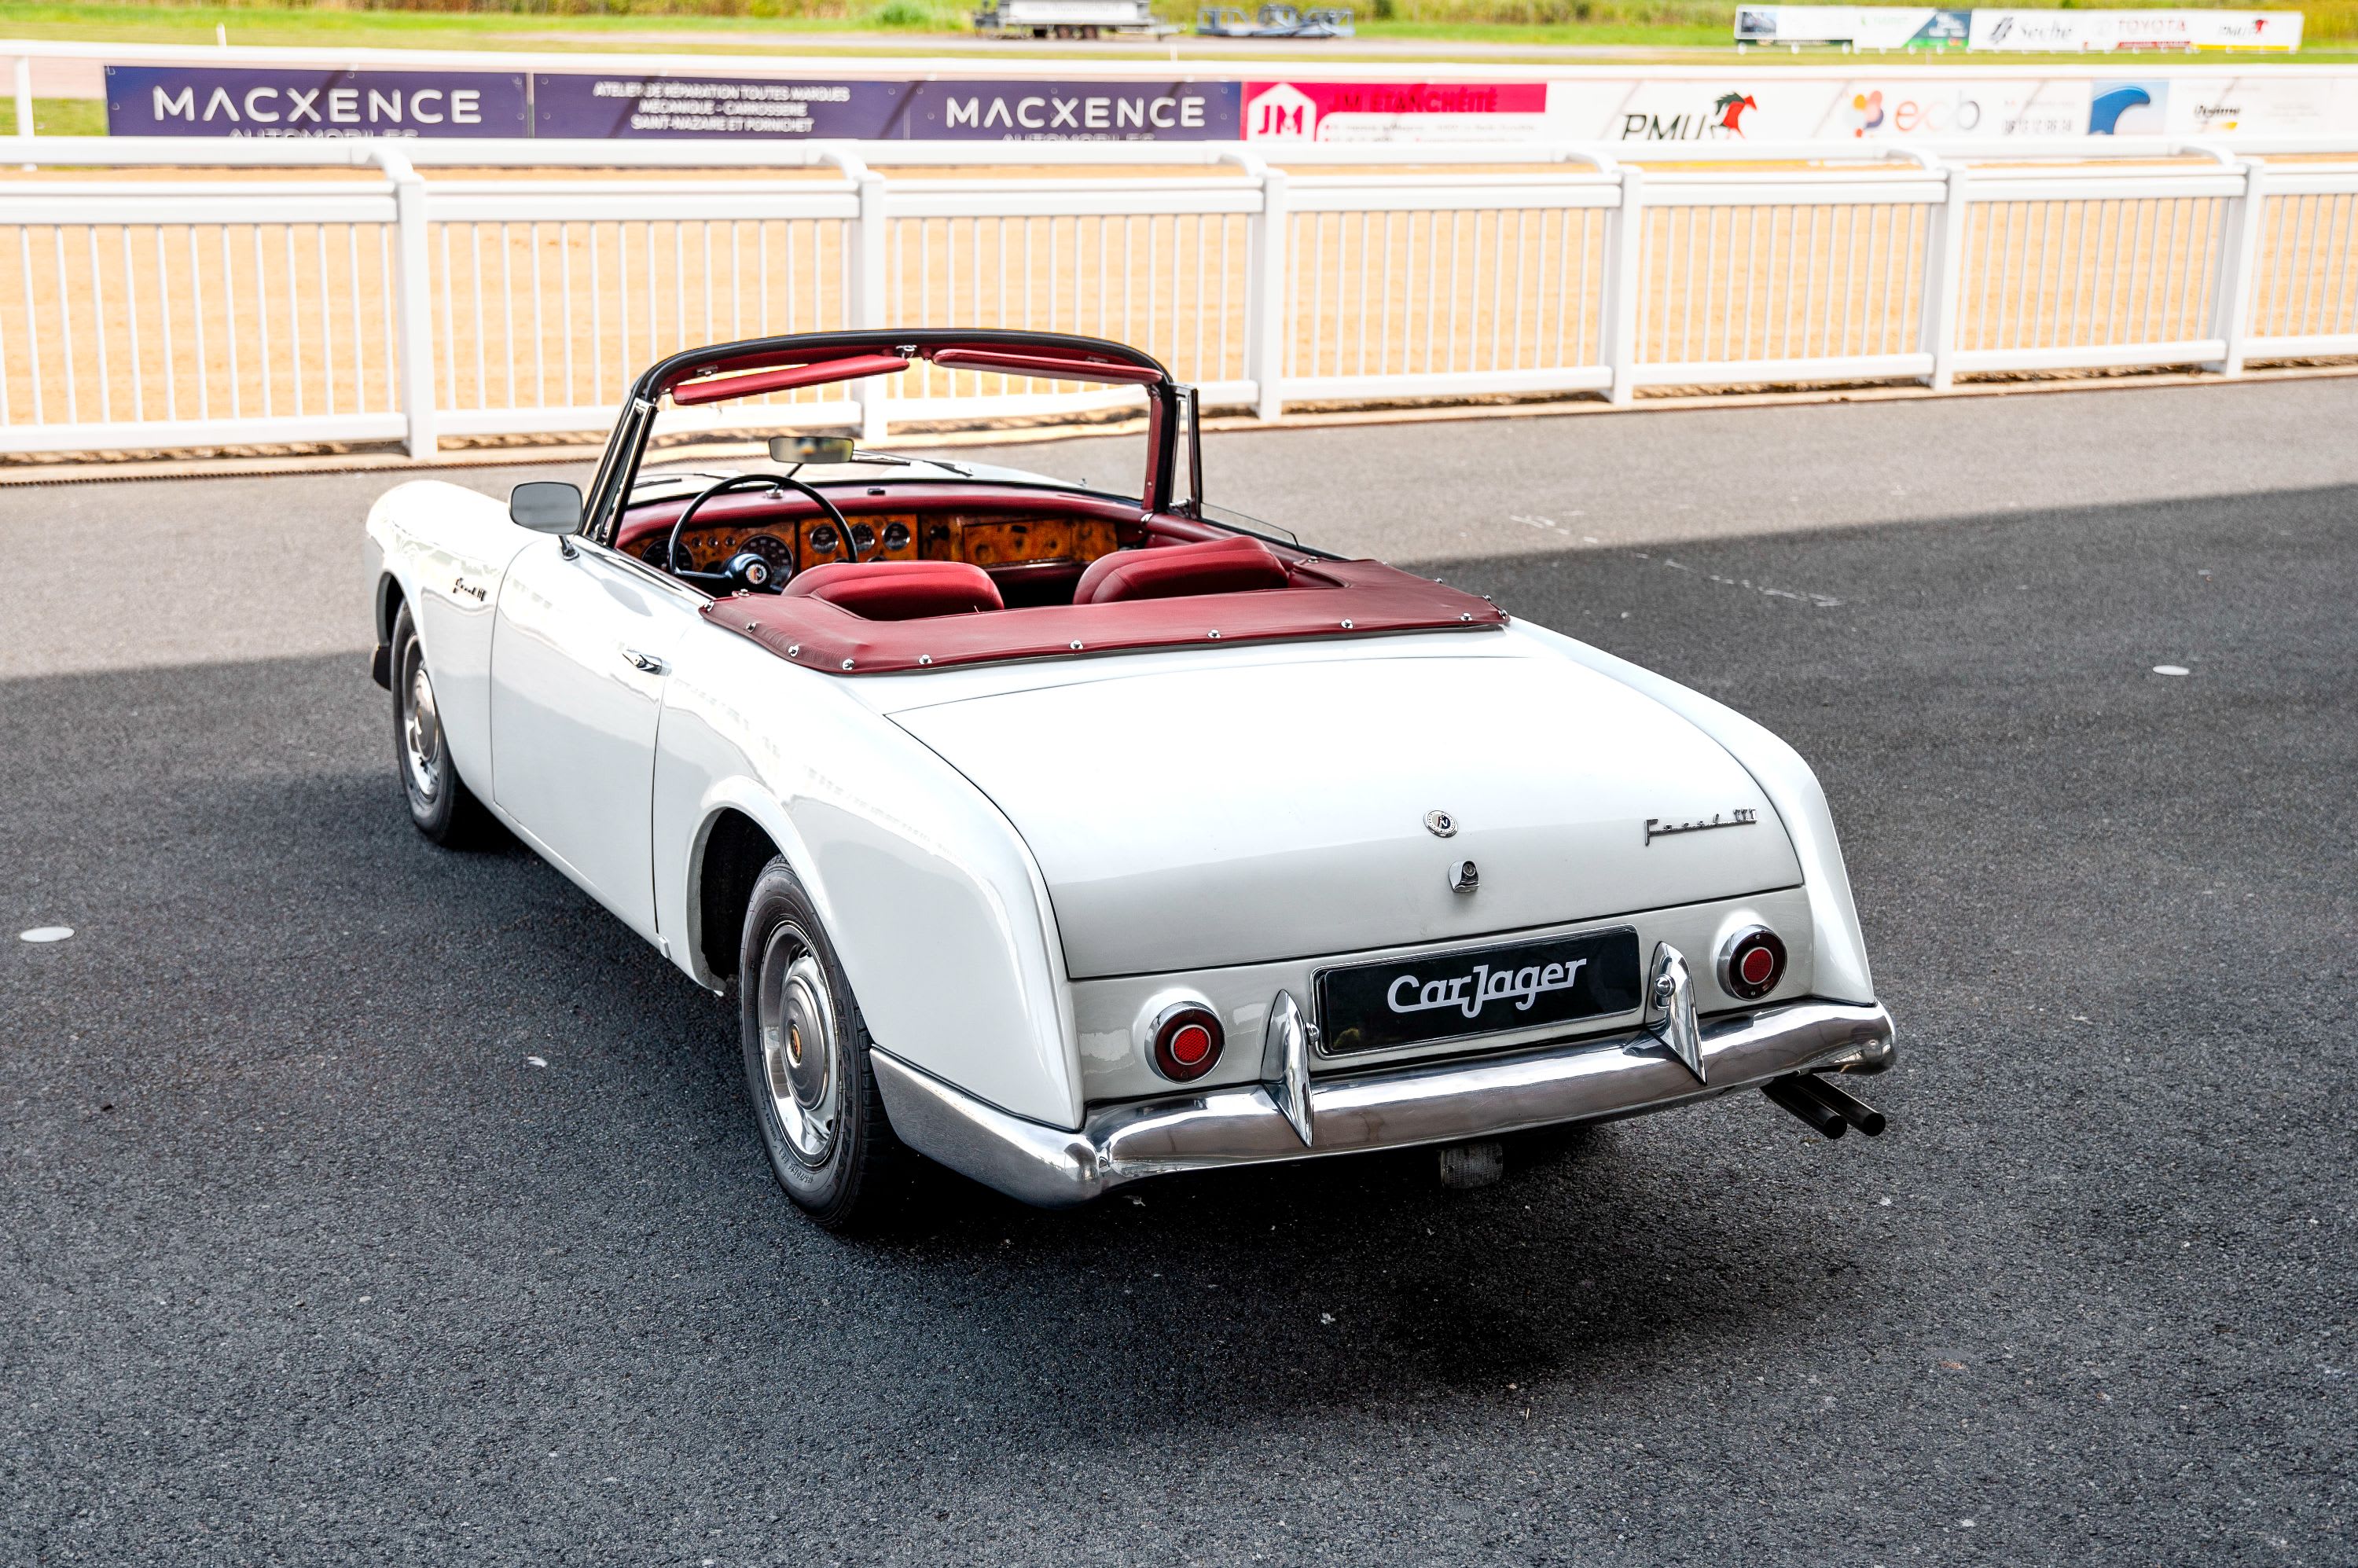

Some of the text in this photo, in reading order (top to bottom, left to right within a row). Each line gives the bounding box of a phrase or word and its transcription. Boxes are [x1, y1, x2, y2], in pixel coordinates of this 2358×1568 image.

[2118, 20, 2187, 34] TOYOTA
[152, 86, 482, 124] MACXENCE
[593, 81, 644, 97] ATELIER
[740, 85, 789, 101] TOUTES
[791, 86, 850, 102] MARQUES
[727, 116, 744, 132] ET
[946, 97, 1206, 129] MACXENCE
[1258, 105, 1303, 135] JM
[1622, 114, 1706, 141] PMU
[1387, 957, 1587, 1019] CarJager
